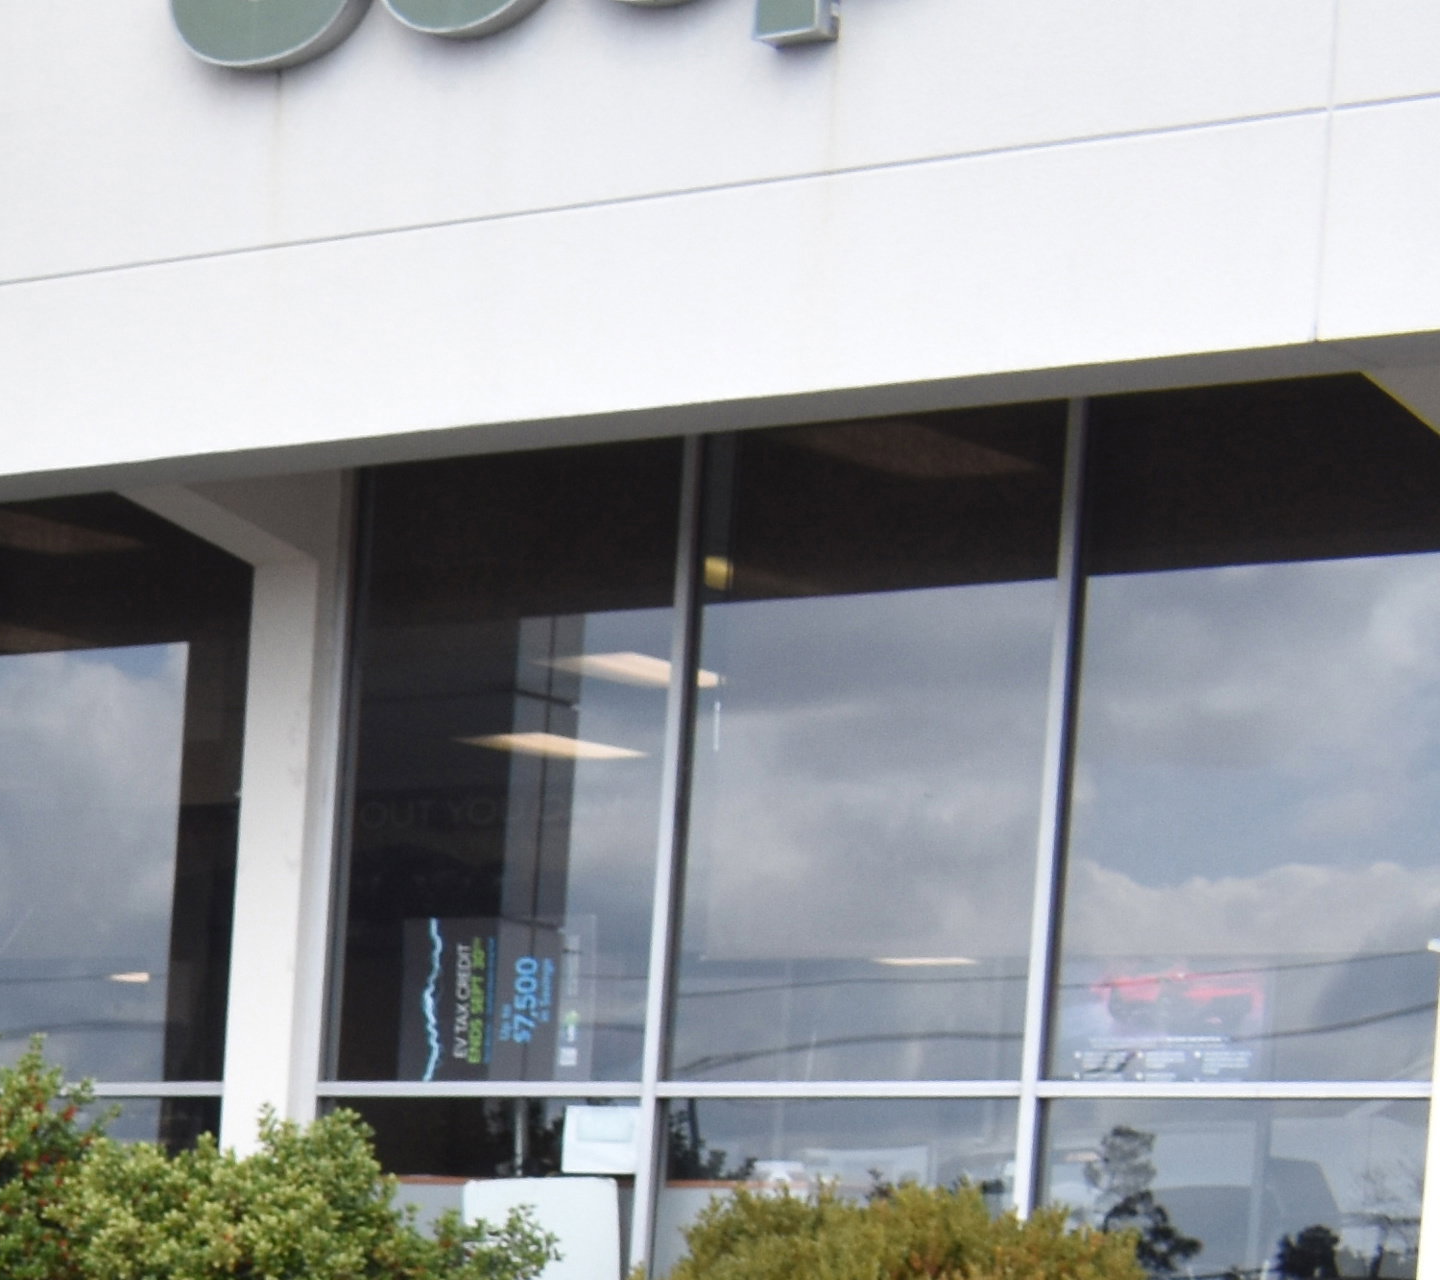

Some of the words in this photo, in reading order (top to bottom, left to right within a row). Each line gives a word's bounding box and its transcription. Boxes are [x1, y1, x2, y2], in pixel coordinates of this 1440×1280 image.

[455, 943, 472, 1000] CREDIT
[454, 1003, 470, 1034] TAX
[513, 956, 538, 1044] $7,500
[453, 1037, 468, 1059] EV
[468, 1018, 484, 1064] ENDS
